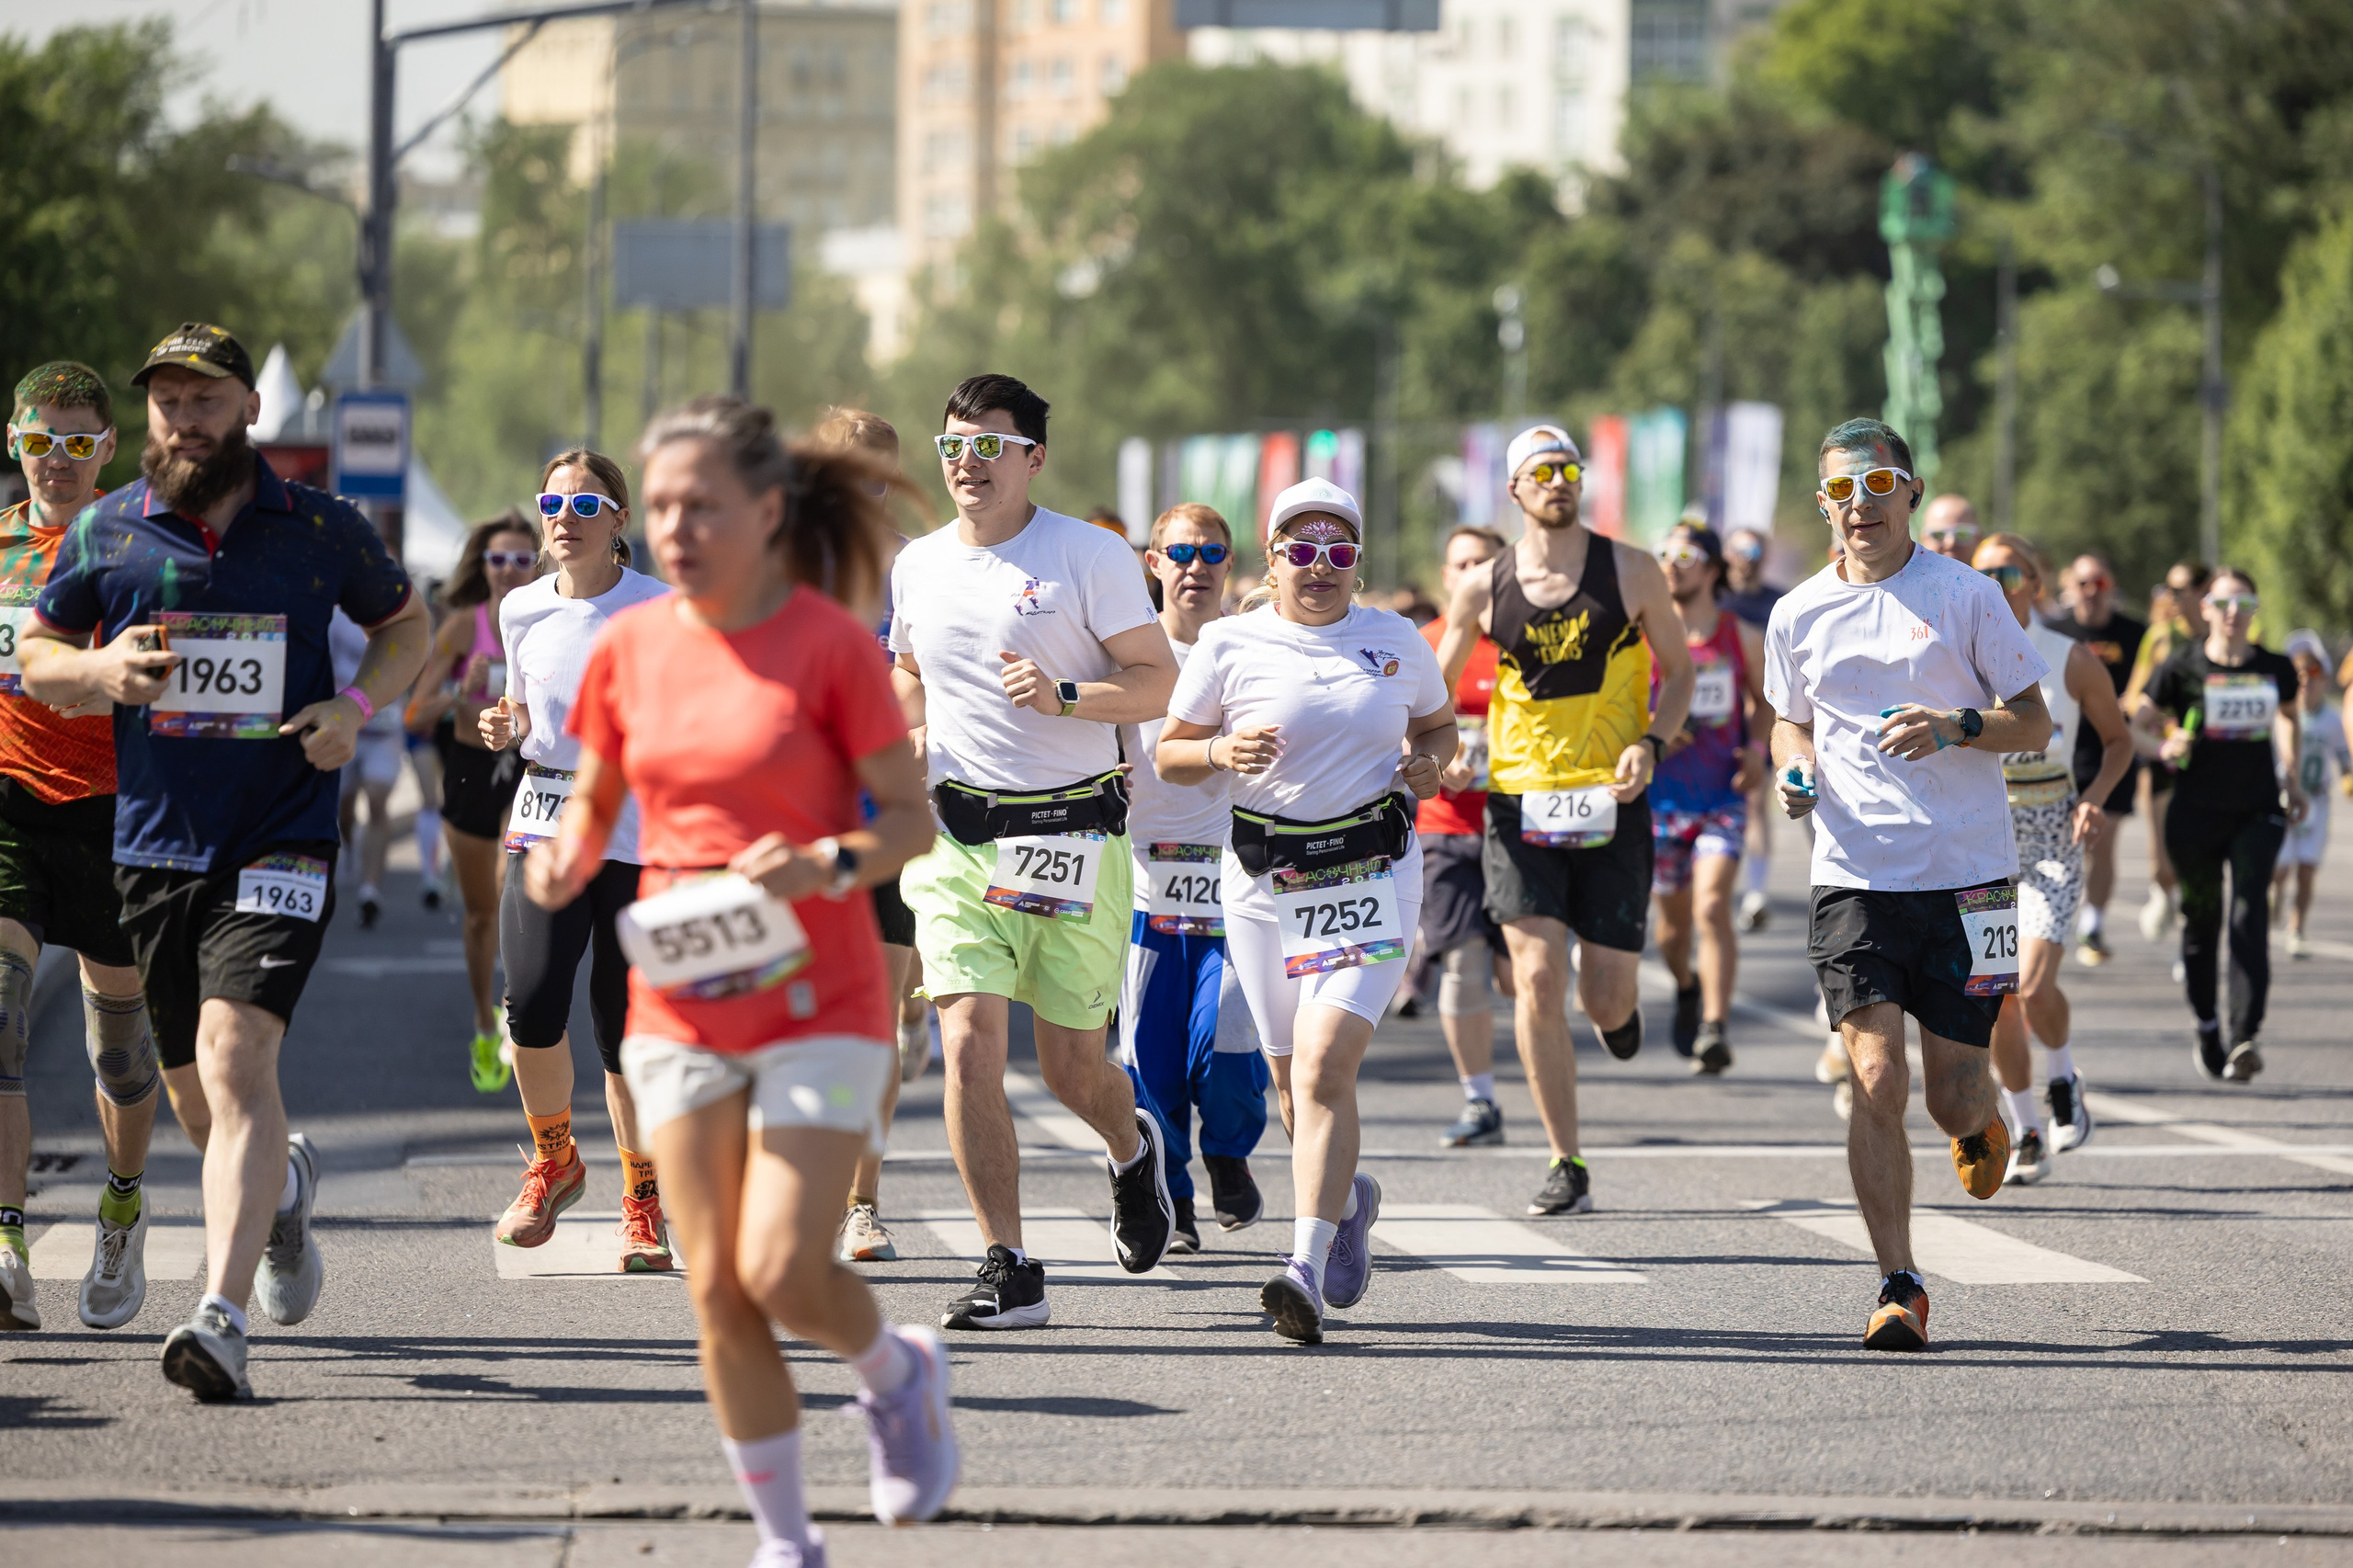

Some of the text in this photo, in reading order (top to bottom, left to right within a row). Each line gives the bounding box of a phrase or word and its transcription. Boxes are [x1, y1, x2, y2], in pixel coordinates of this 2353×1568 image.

[174, 657, 263, 696] 1963
[520, 790, 573, 822] 817
[1548, 795, 1591, 818] 216
[1015, 845, 1085, 886] 7251
[1341, 870, 1392, 886] 2026
[254, 885, 313, 914] 1963
[650, 903, 768, 965] 5513
[1294, 896, 1382, 939] 7252
